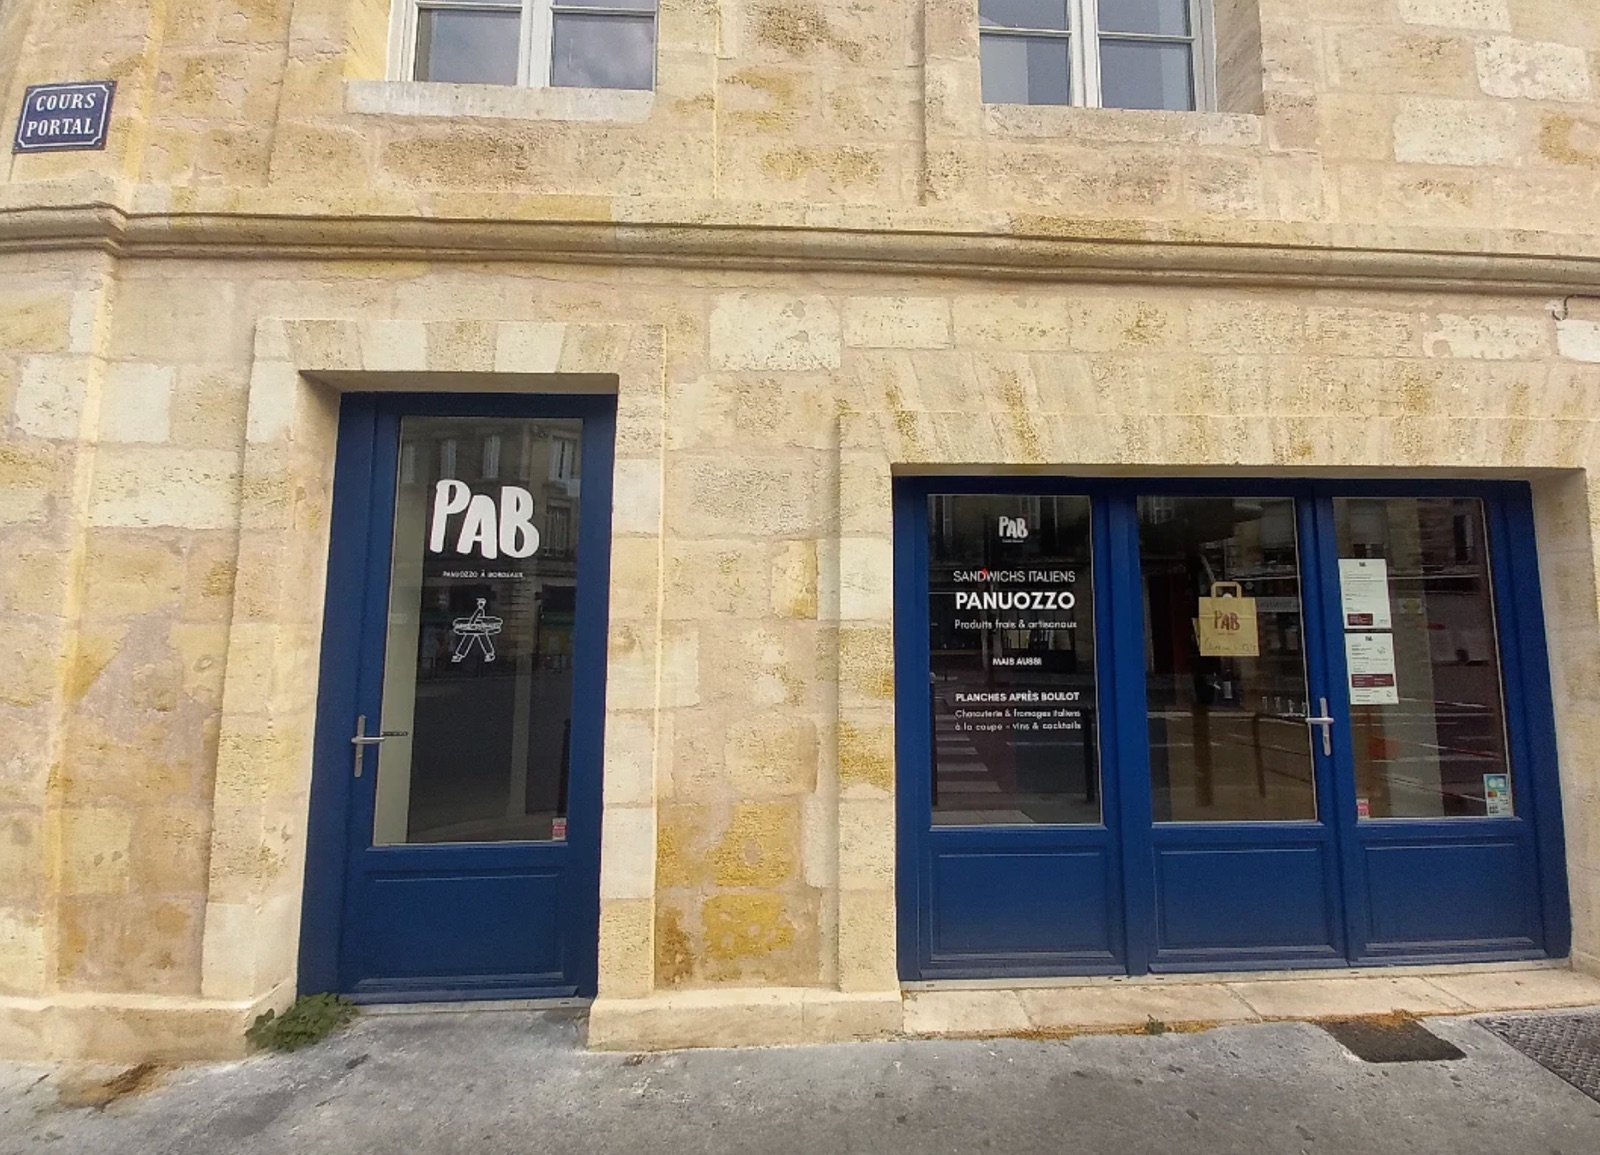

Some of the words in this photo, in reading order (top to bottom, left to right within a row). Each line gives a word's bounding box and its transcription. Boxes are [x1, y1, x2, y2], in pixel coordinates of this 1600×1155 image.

[36, 93, 96, 112] COURS
[26, 118, 94, 137] PORTAL
[429, 479, 540, 559] PAB
[998, 515, 1029, 539] PAB
[953, 570, 1026, 582] SANDWICHS
[1028, 570, 1076, 582] ITALIENS
[955, 591, 1076, 610] PANUOZZO
[954, 619, 993, 630] Produits
[994, 619, 1016, 631] frais
[1018, 619, 1026, 629] &
[1214, 610, 1240, 630] PAB
[992, 657, 1015, 666] MAIS
[1016, 657, 1042, 666] AUSSI
[955, 693, 1007, 702] PLANCHES
[1008, 690, 1039, 701] APRÈS
[1041, 691, 1080, 701] BOULOT
[1004, 709, 1011, 717] &
[1013, 708, 1051, 719] fromages
[963, 722, 973, 731] la
[975, 724, 1003, 732] coupe
[1012, 722, 1030, 730] vins
[1032, 722, 1039, 731] &
[1042, 720, 1081, 730] cocktails
